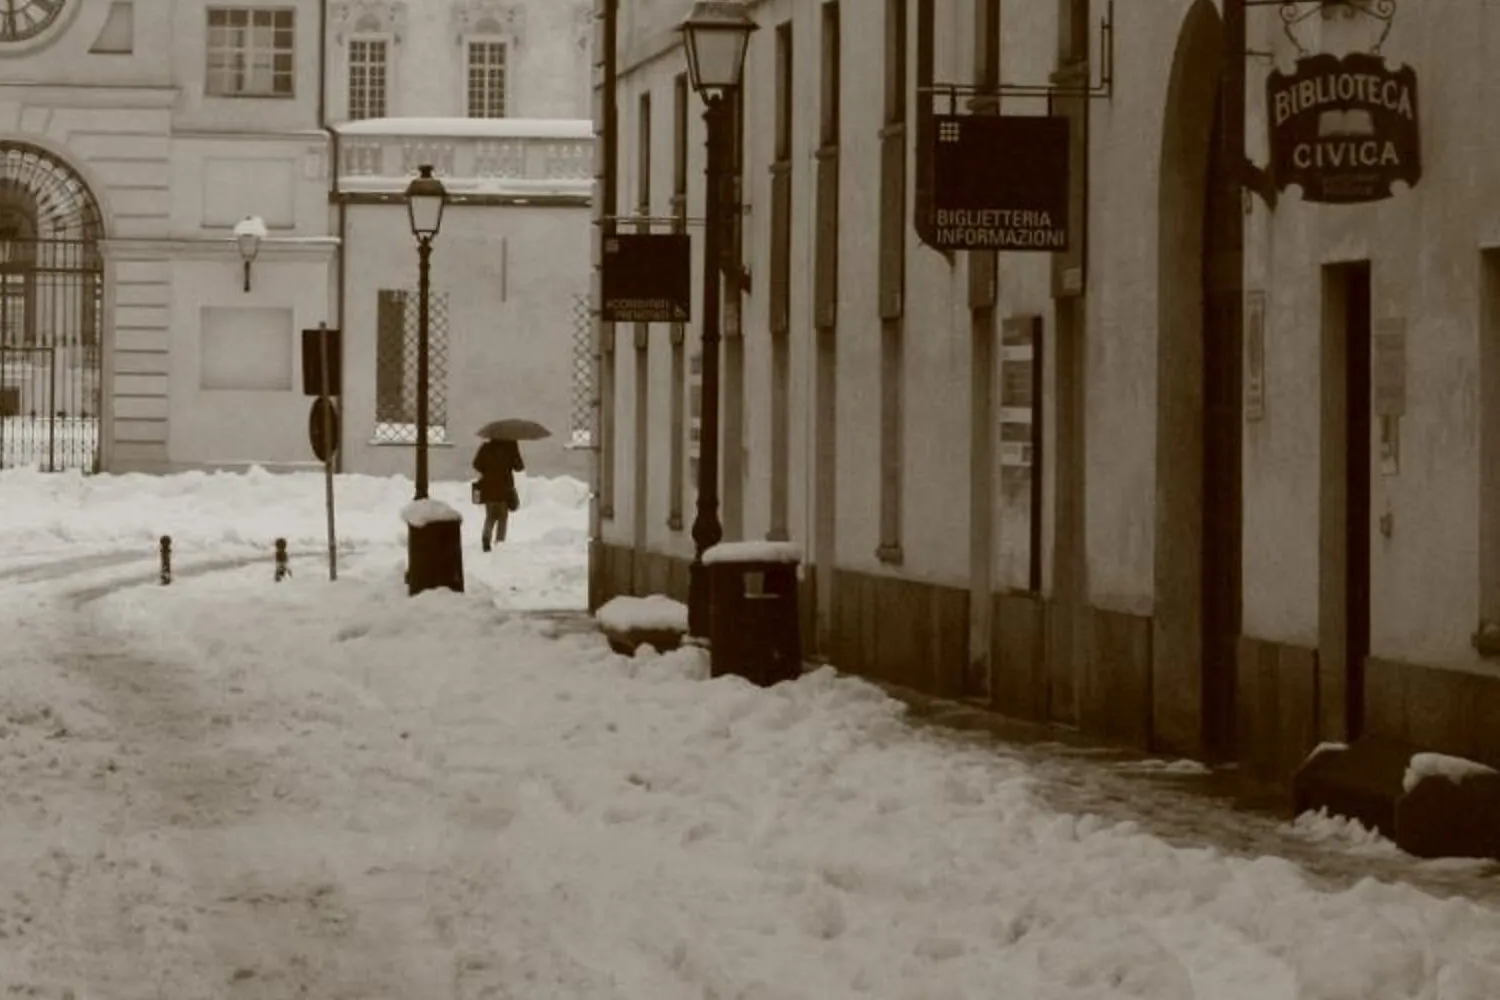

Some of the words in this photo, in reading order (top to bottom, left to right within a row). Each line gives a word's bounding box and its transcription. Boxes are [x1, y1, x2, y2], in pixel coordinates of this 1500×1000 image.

[1274, 72, 1414, 128] BIBLIOTECA
[1292, 140, 1400, 169] CIVICA
[936, 208, 1052, 228] BIGLIETTERIA
[936, 228, 1065, 247] INFORMAZIONI
